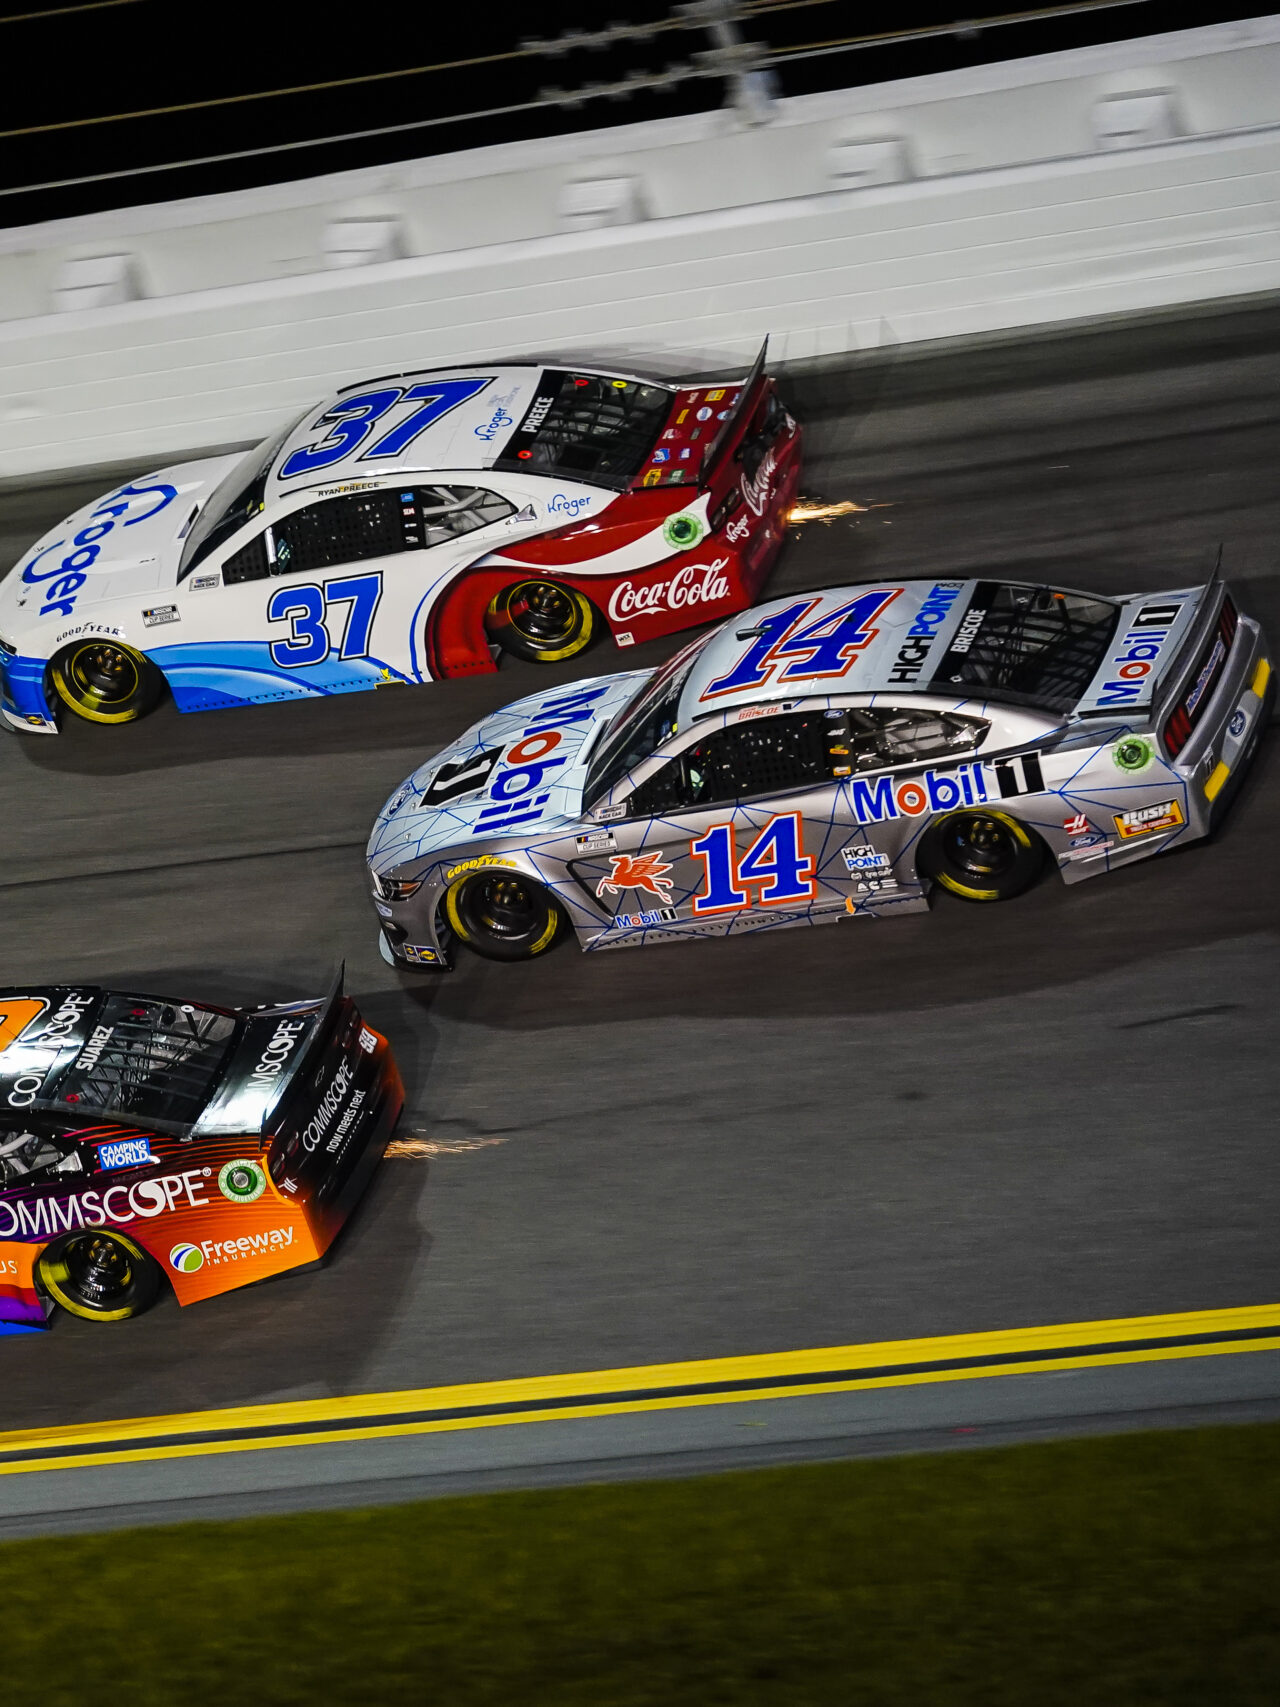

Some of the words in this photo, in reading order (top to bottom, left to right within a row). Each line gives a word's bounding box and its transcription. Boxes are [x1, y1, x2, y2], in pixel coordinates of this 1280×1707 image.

[277, 376, 499, 480] 37
[474, 408, 513, 440] Kroger
[521, 396, 554, 433] PREECE
[318, 488, 341, 497] RYAN
[344, 481, 380, 493] PREECE
[547, 494, 592, 517] Kroger
[22, 475, 178, 616] Kroger
[608, 556, 730, 622] Coca-Cola
[56, 622, 120, 642] GOODYEAR
[267, 570, 384, 669] 37
[950, 609, 987, 653] BRISCOE
[699, 588, 906, 702] 14
[1096, 630, 1170, 706] Mobil
[472, 686, 612, 834] Mobil
[851, 762, 987, 824] Mobil
[1122, 802, 1172, 826] RUSH
[447, 854, 517, 879] GOODYEAR
[689, 810, 818, 916] 14
[843, 847, 874, 859] HIGH
[847, 856, 883, 869] POINT
[615, 911, 661, 929] Mobil
[75, 1025, 114, 1071] SUAREZ
[303, 1057, 354, 1152] COMMSCOPE
[326, 1132, 343, 1153] now
[338, 1107, 357, 1138] meets
[350, 1089, 366, 1111] next
[100, 1140, 147, 1156] CAMPING
[102, 1151, 149, 1168] WORLD
[201, 1226, 294, 1259] Freeway
[207, 1243, 285, 1266] INSURANCE
